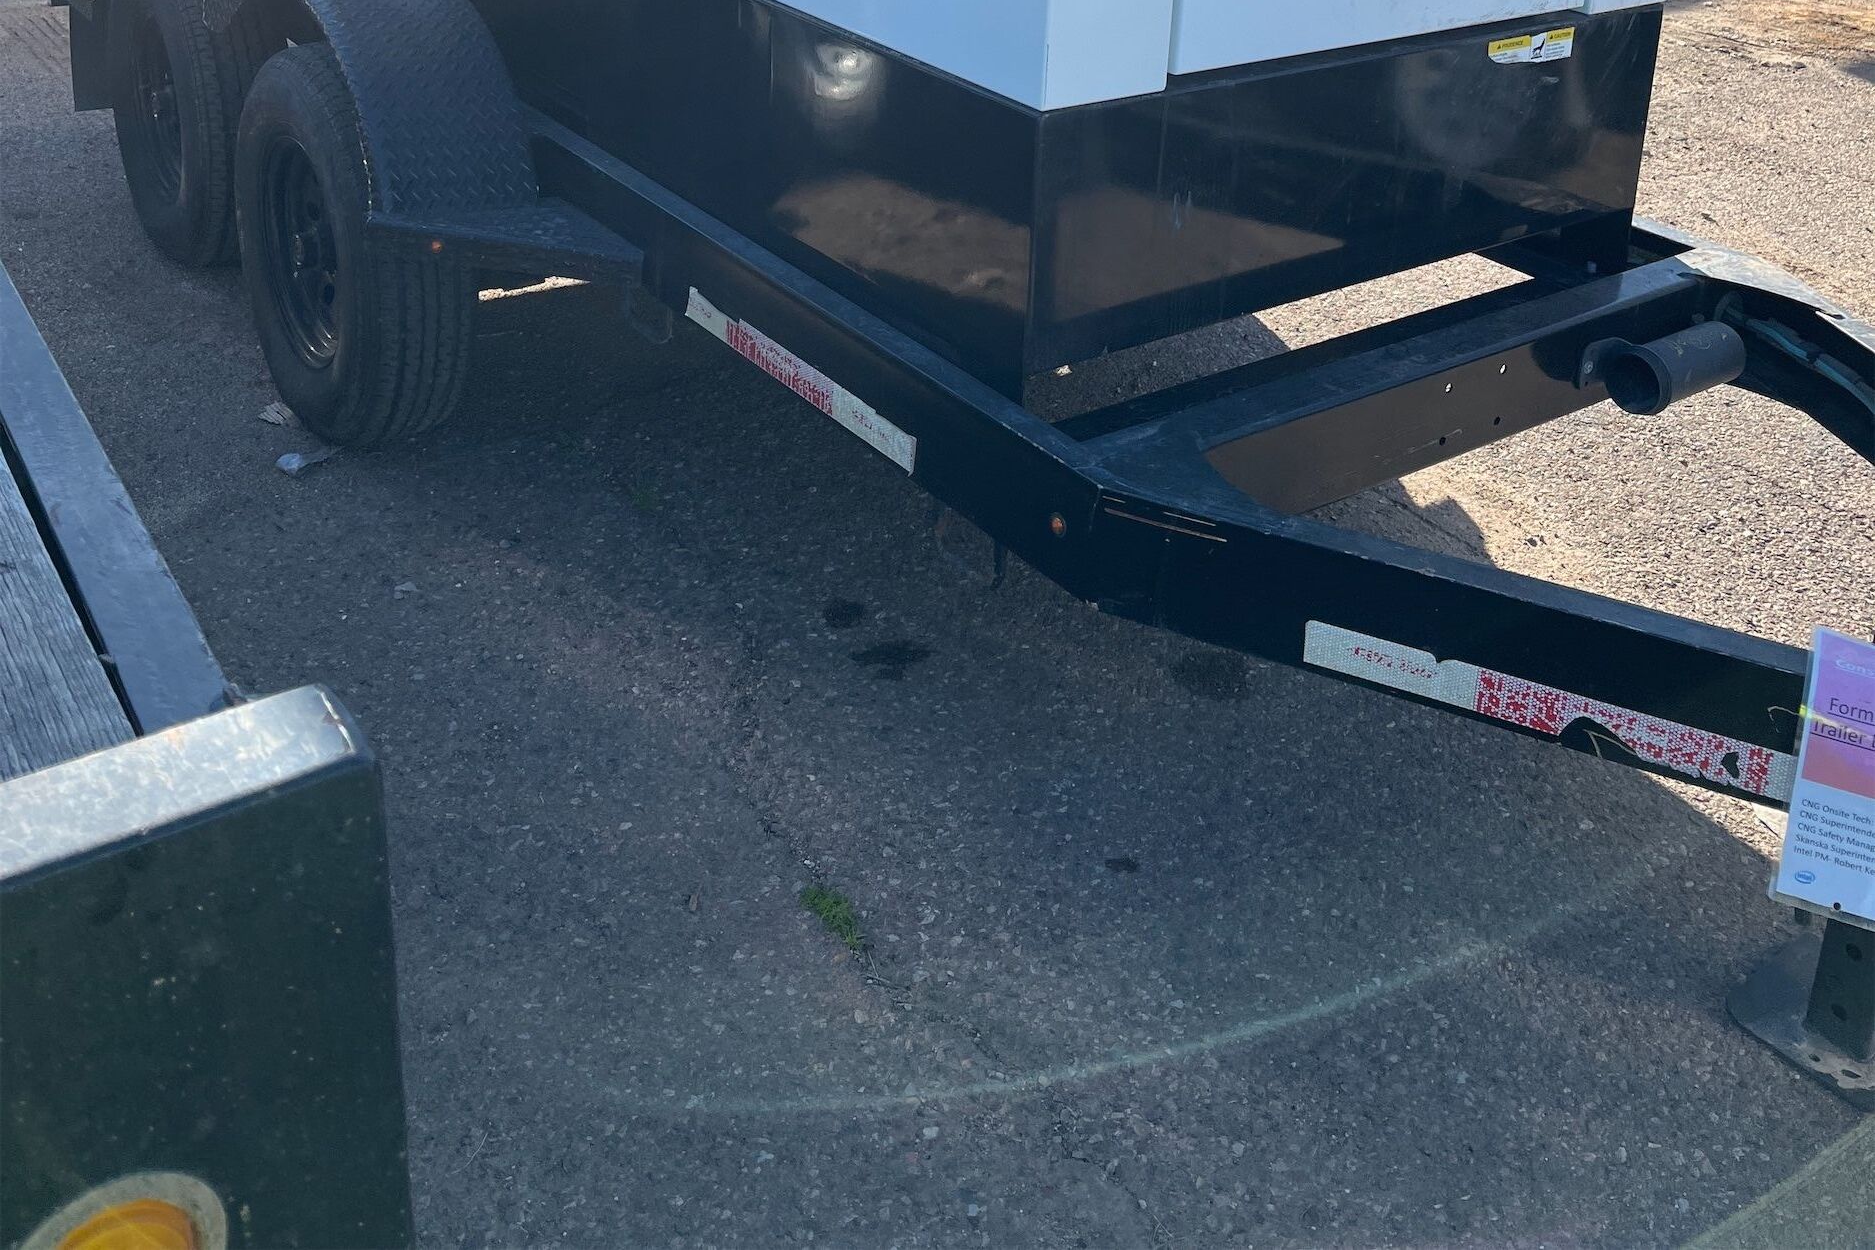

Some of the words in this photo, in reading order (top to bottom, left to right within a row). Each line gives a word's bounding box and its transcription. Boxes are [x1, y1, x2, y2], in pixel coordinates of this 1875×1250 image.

[1810, 718, 1867, 746] Trailer
[1799, 810, 1818, 822] CNG
[1801, 798, 1820, 810] CNG
[1822, 805, 1850, 819] Onsite
[1795, 834, 1829, 849] Skanska
[1797, 822, 1816, 834] CNG
[1818, 828, 1845, 843] Safety
[1793, 845, 1813, 857] Intel
[1834, 857, 1862, 872] Robert
